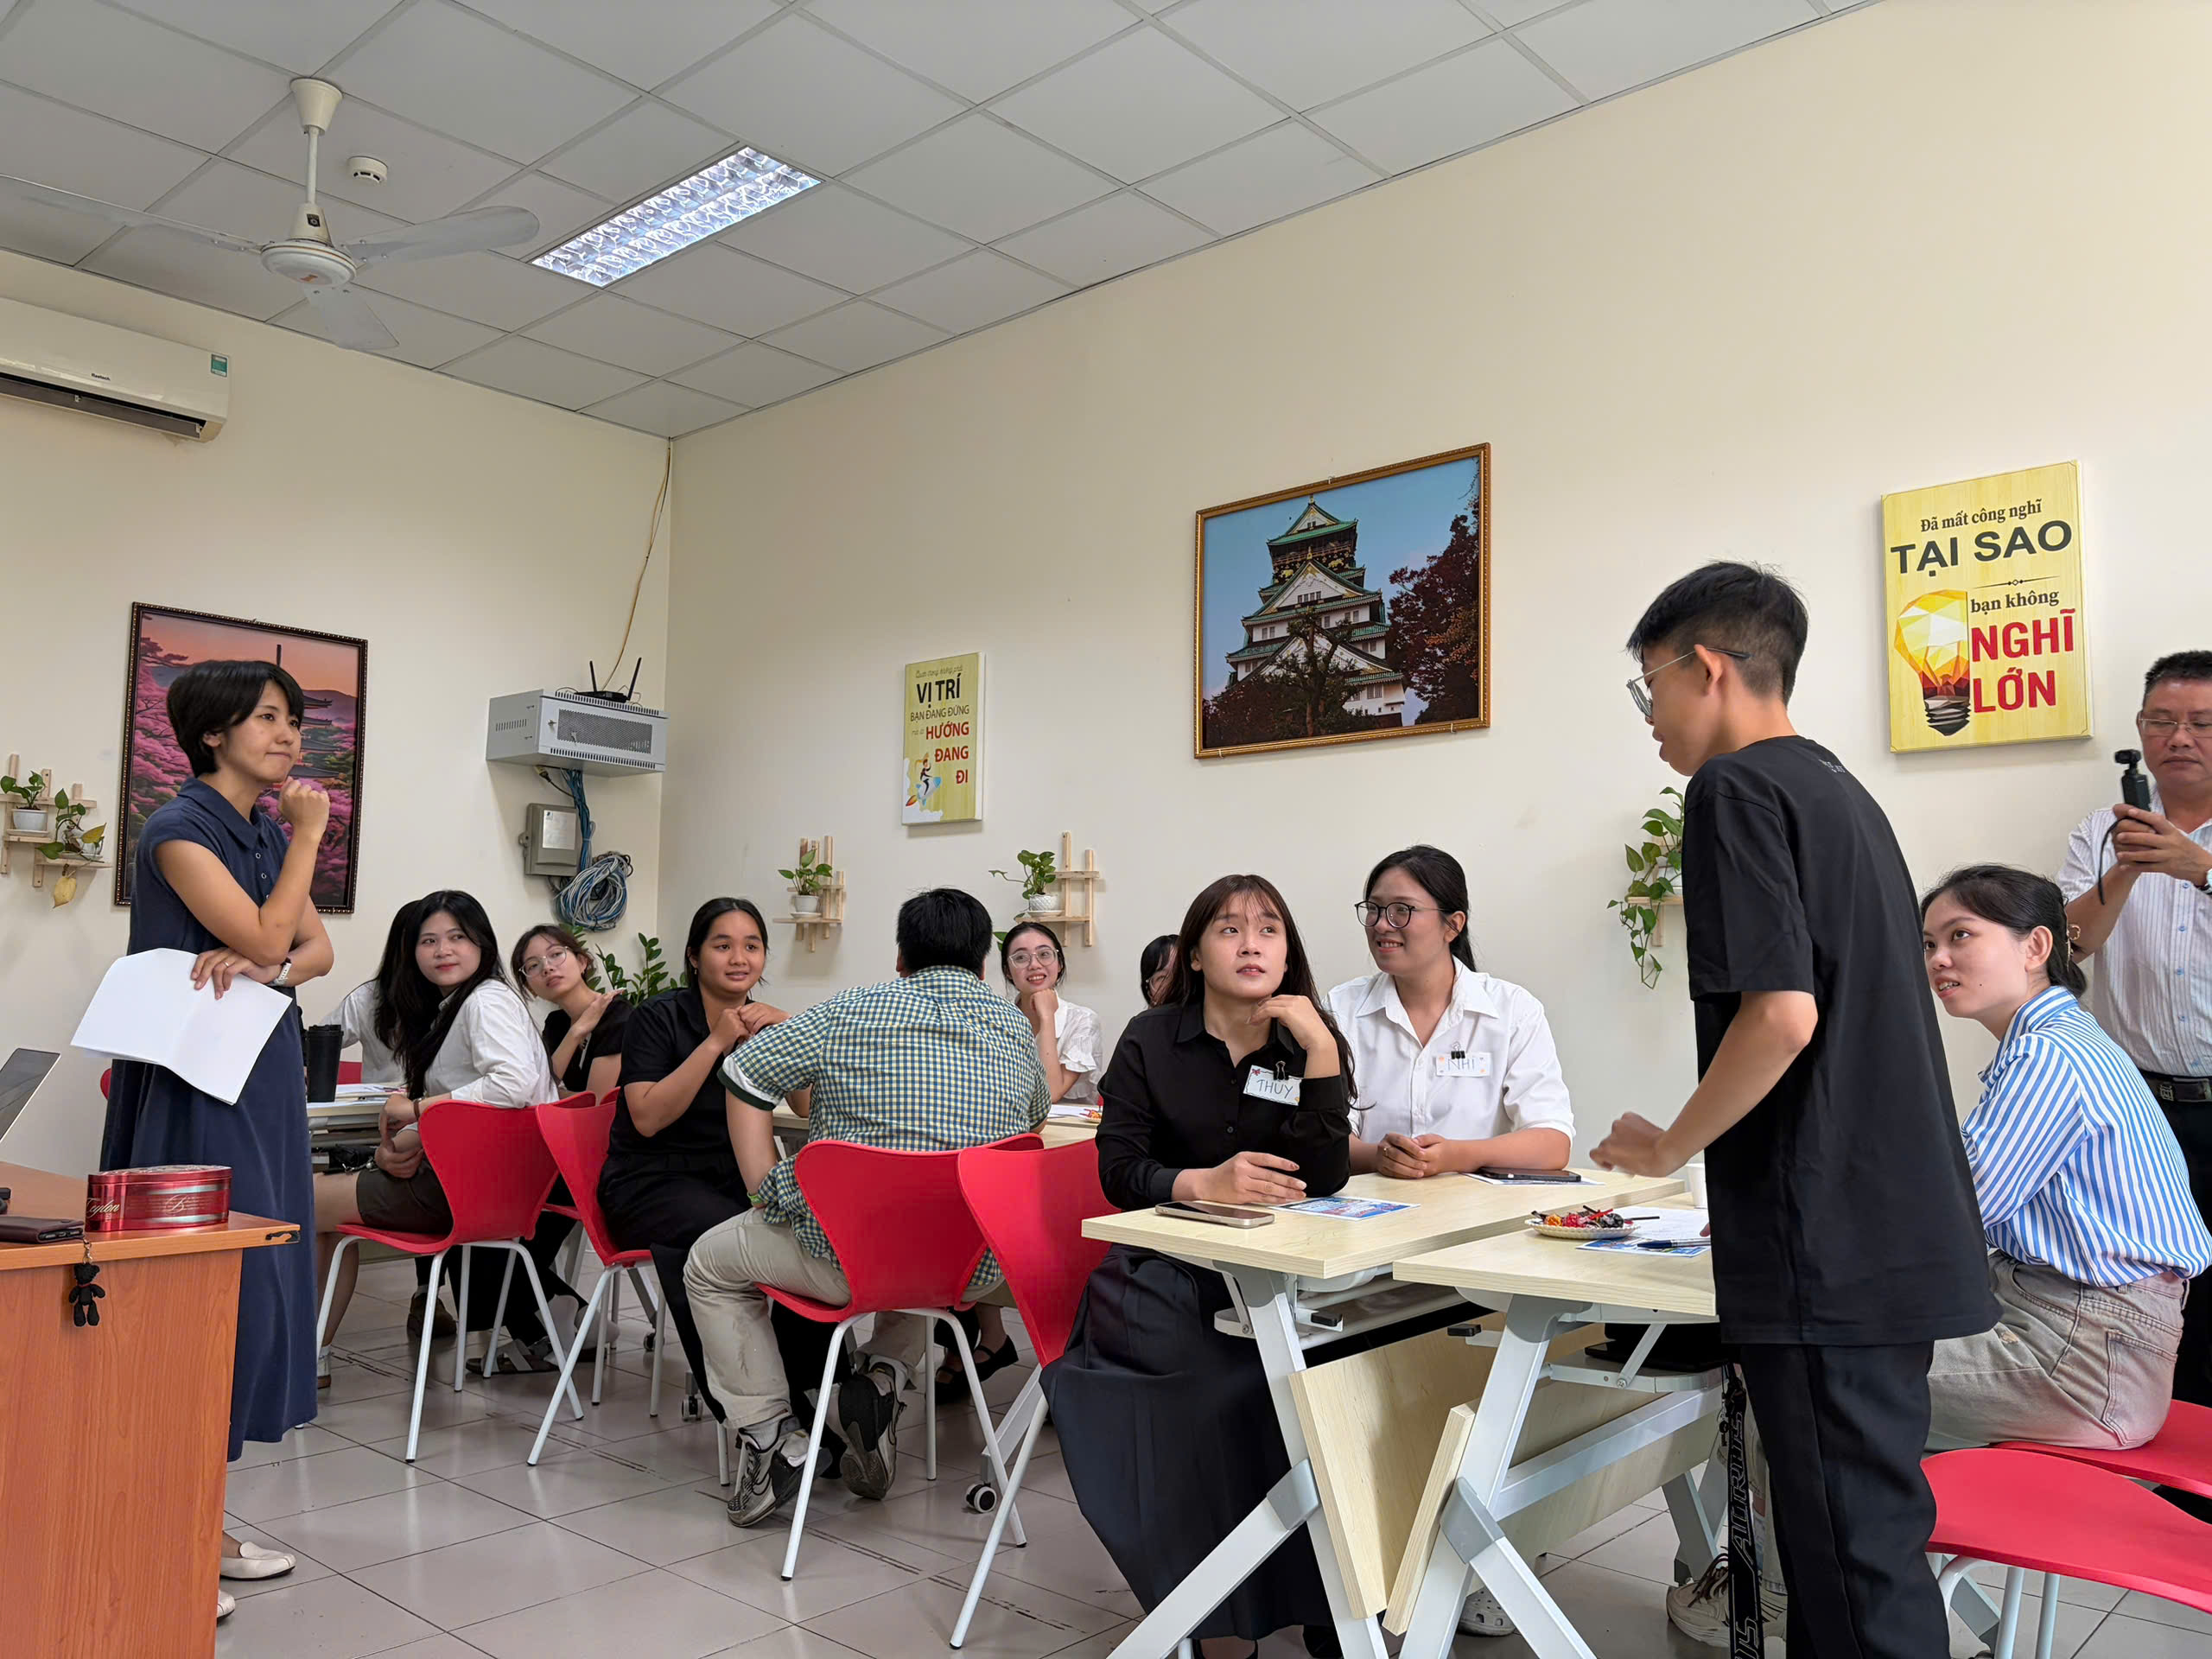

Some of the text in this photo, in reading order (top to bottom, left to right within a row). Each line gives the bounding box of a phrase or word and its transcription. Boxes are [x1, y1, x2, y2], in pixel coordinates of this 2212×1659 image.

[1920, 499, 2042, 532] Đã mất công nghĩ
[1891, 519, 2072, 577] TẠI SAO
[1970, 590, 2060, 615] bạn không
[1971, 608, 2075, 663] NGHĨ
[917, 672, 962, 709] VỊ TRÍ
[1973, 666, 2056, 713] LỚN
[910, 704, 969, 723] BẠN ĐANG ĐỨNG
[925, 721, 969, 740] HƯỚNG
[934, 745, 969, 762] ĐANG
[956, 769, 968, 784] ĐI
